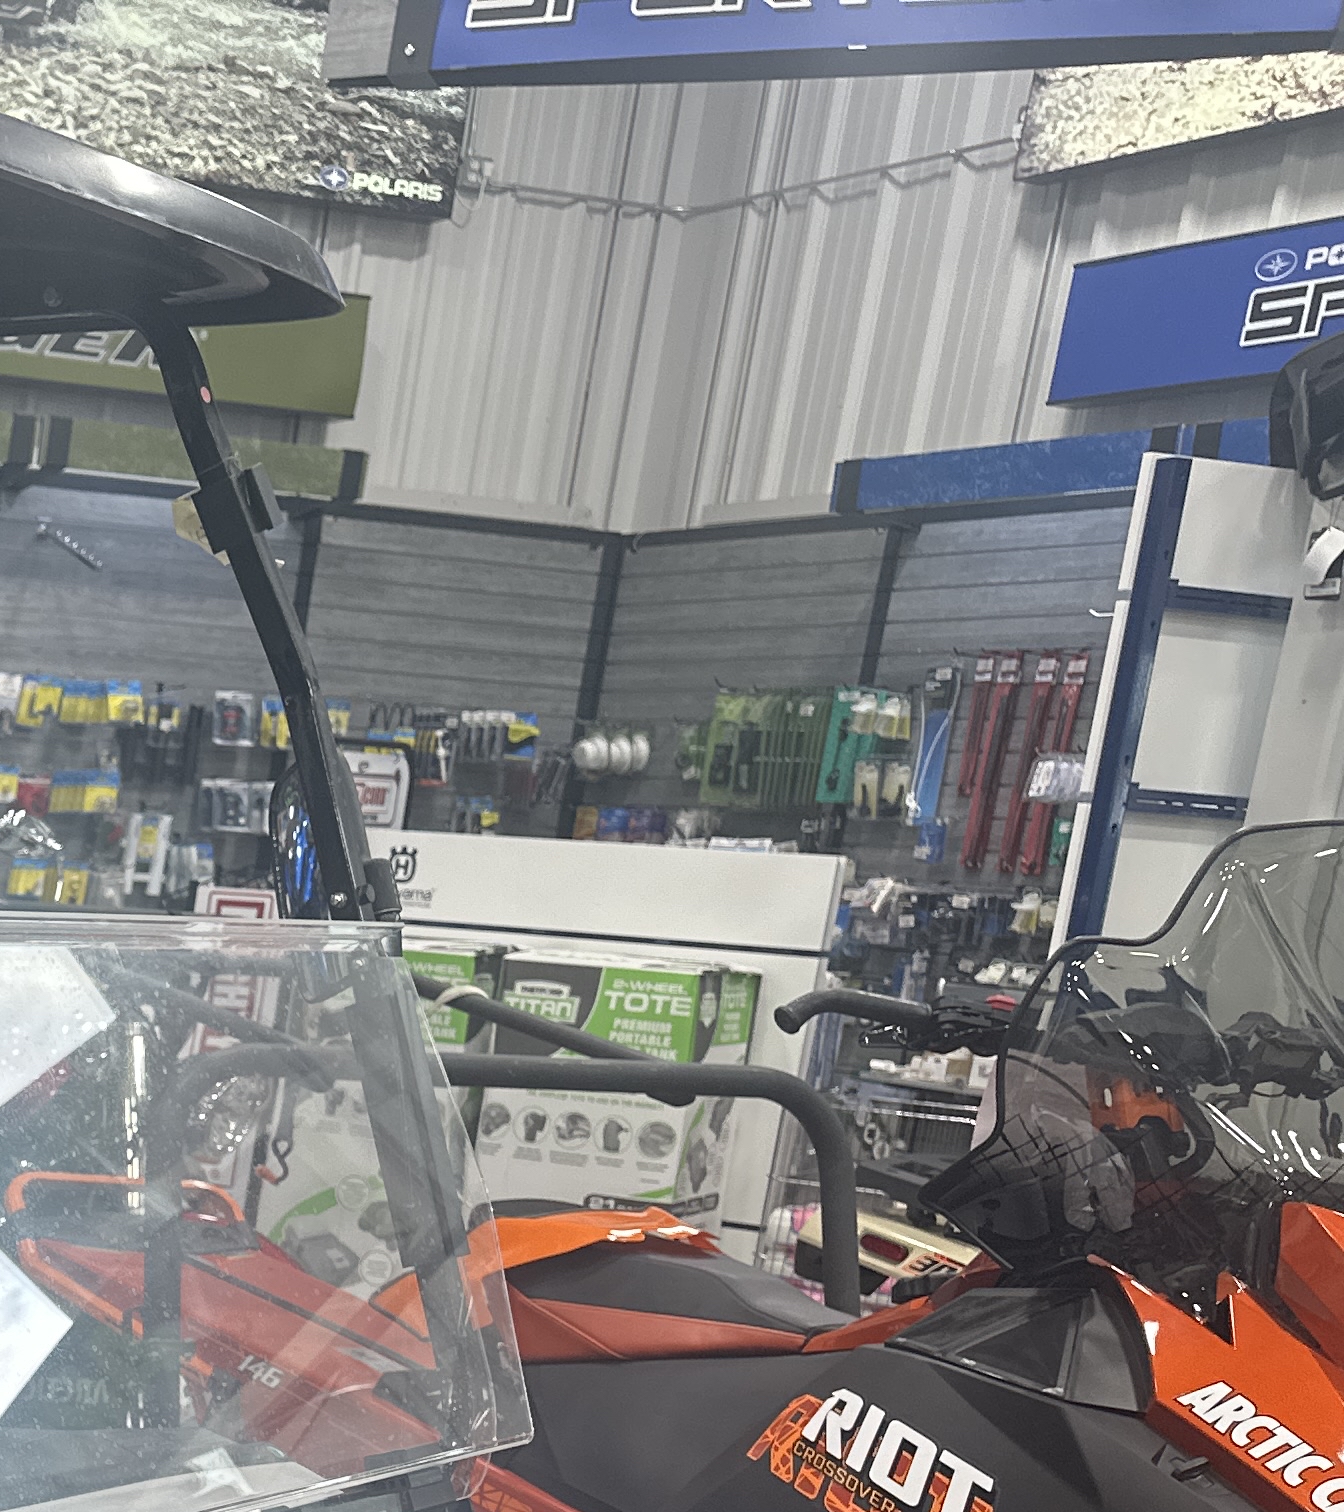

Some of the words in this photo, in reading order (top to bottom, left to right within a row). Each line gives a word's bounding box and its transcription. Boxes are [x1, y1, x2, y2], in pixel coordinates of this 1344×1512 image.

[352, 172, 444, 203] POLARIS
[604, 990, 693, 1018] TOTE
[1173, 1380, 1336, 1489] ARCTIC
